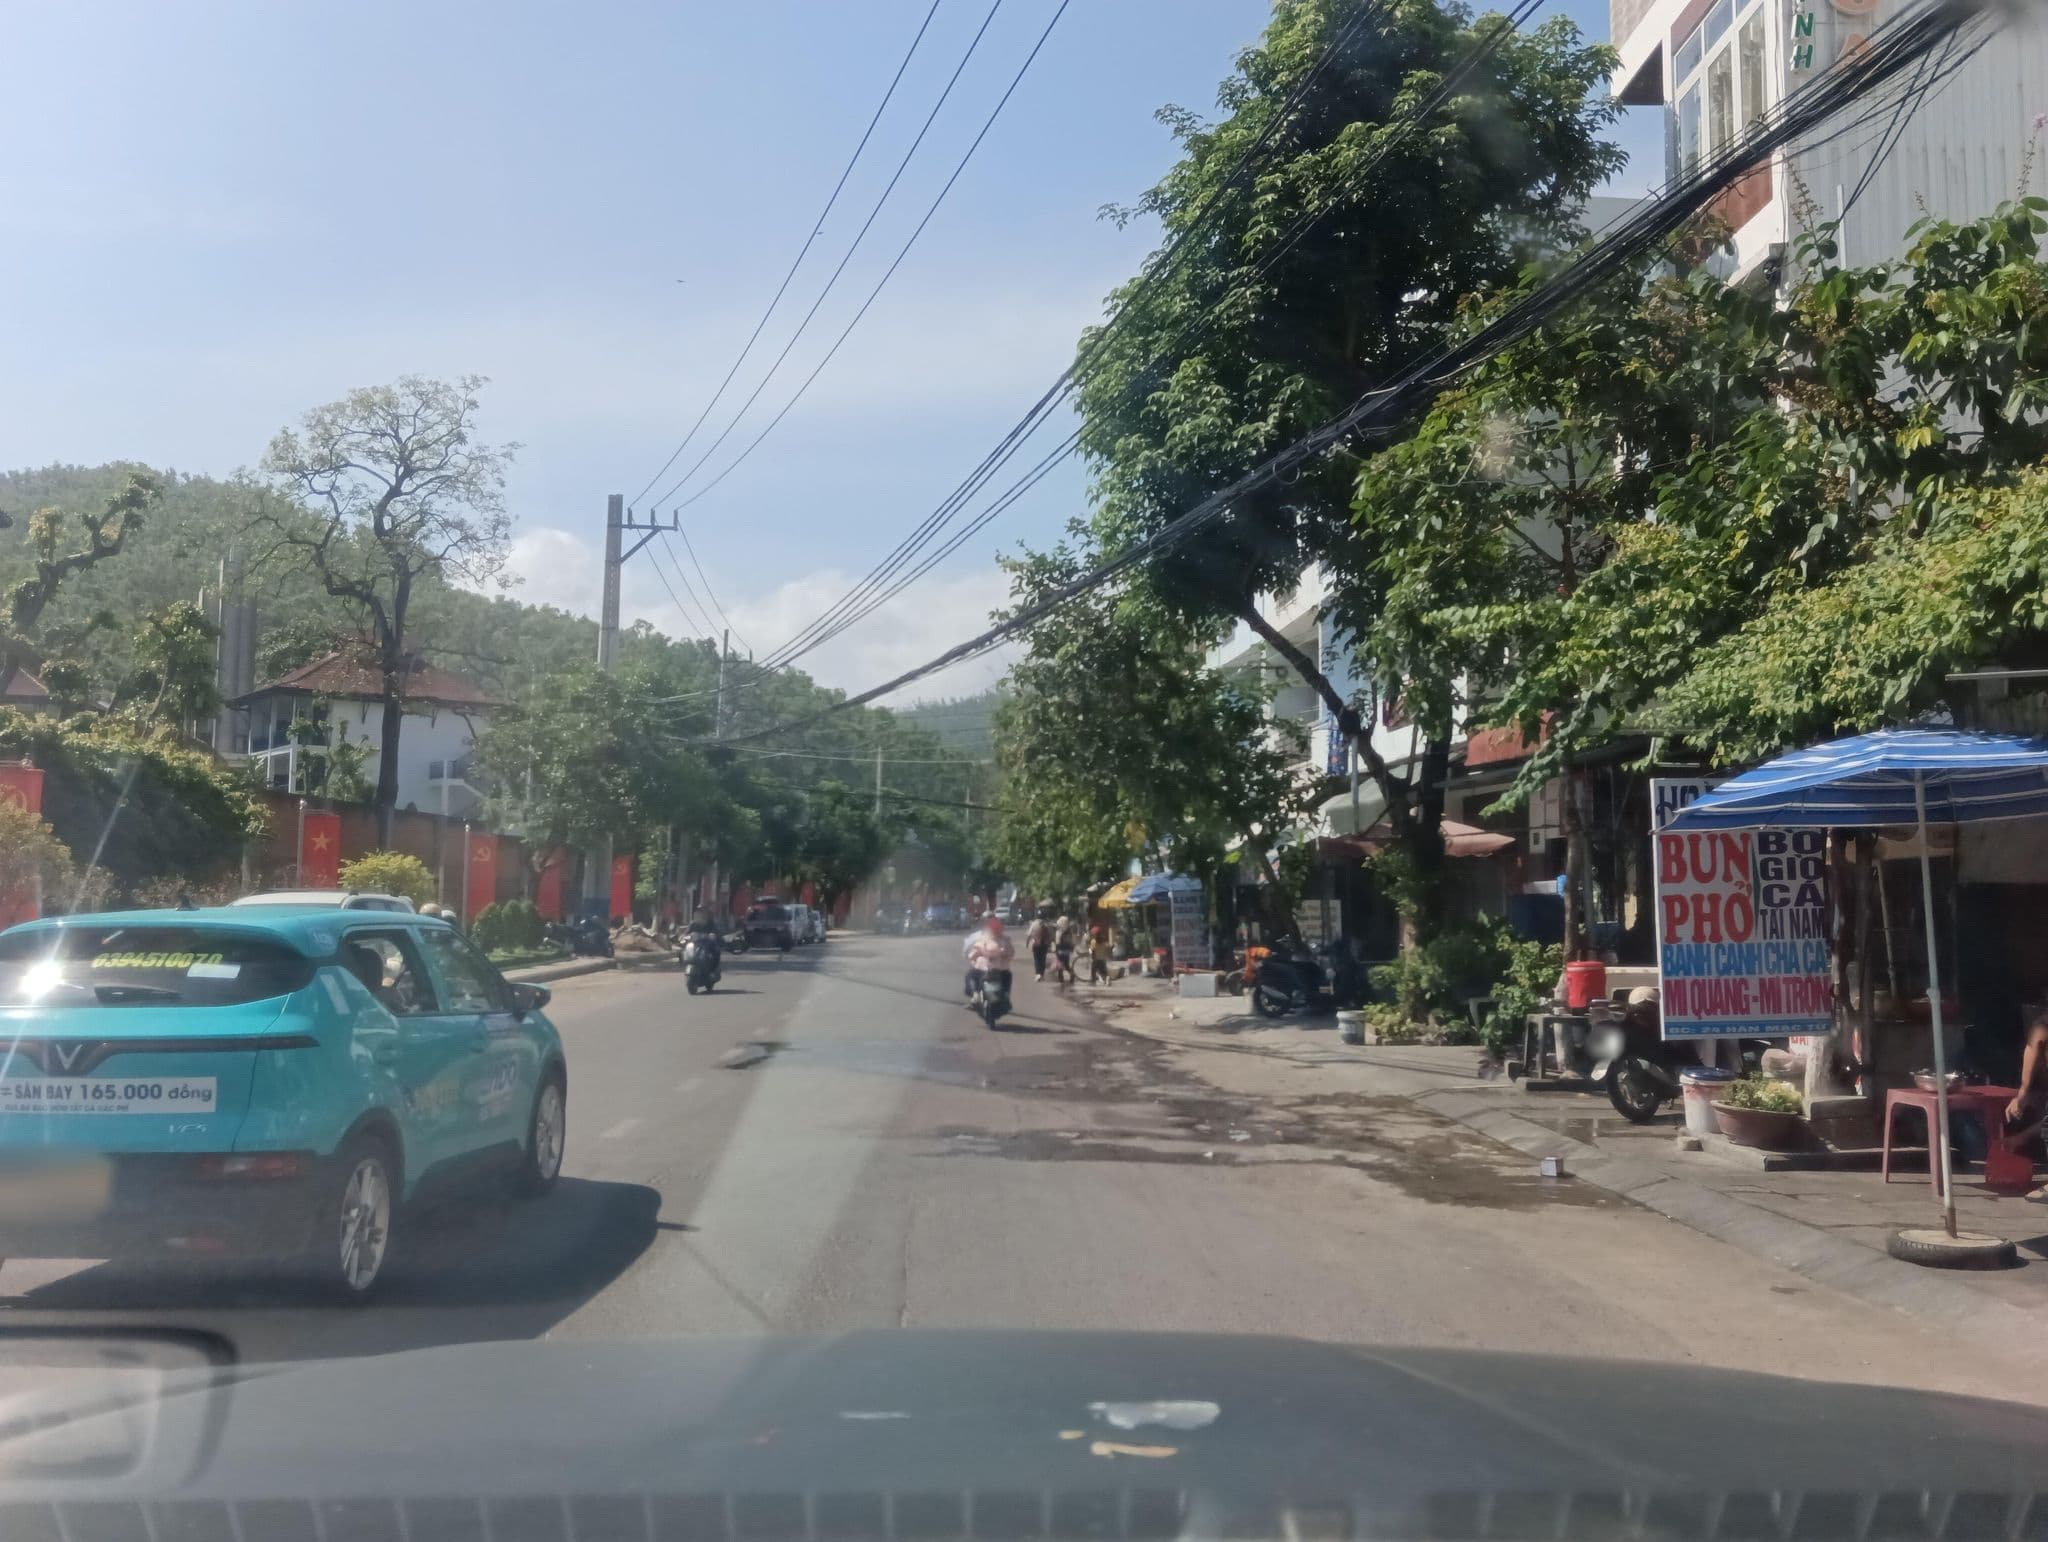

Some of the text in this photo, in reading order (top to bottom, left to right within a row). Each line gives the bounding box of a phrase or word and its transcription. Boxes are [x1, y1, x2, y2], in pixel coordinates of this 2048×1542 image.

[1661, 881, 1754, 944] PHỞ
[46, 1084, 73, 1100] BAY
[80, 1083, 163, 1100] 165.000
[167, 1083, 213, 1102] đồng
